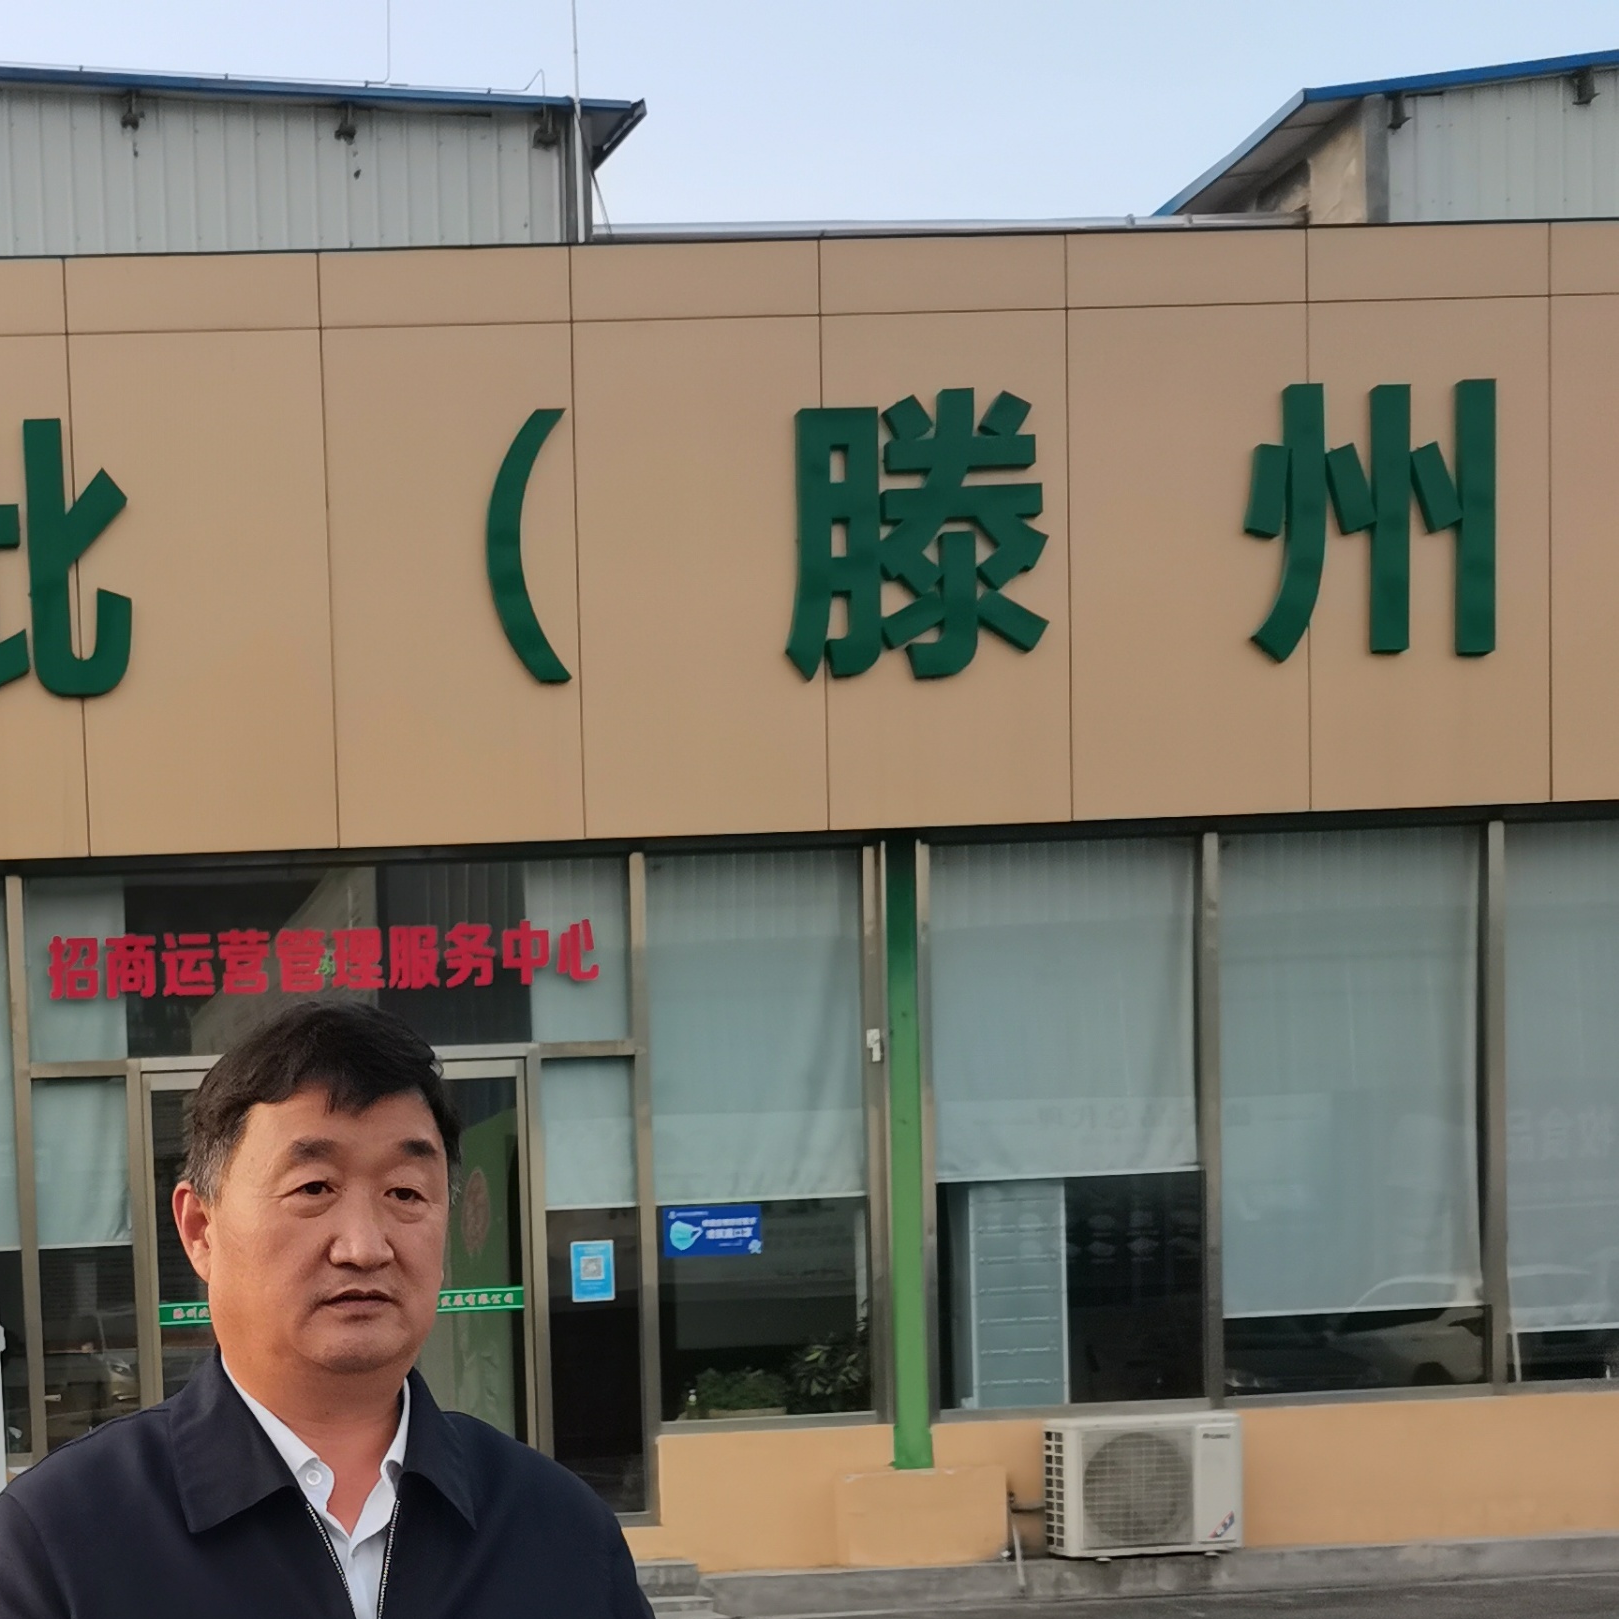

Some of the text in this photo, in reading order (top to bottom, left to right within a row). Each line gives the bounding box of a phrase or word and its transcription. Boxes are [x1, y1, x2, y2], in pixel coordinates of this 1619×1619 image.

[47, 919, 600, 999] 招商运营管理服务中心
